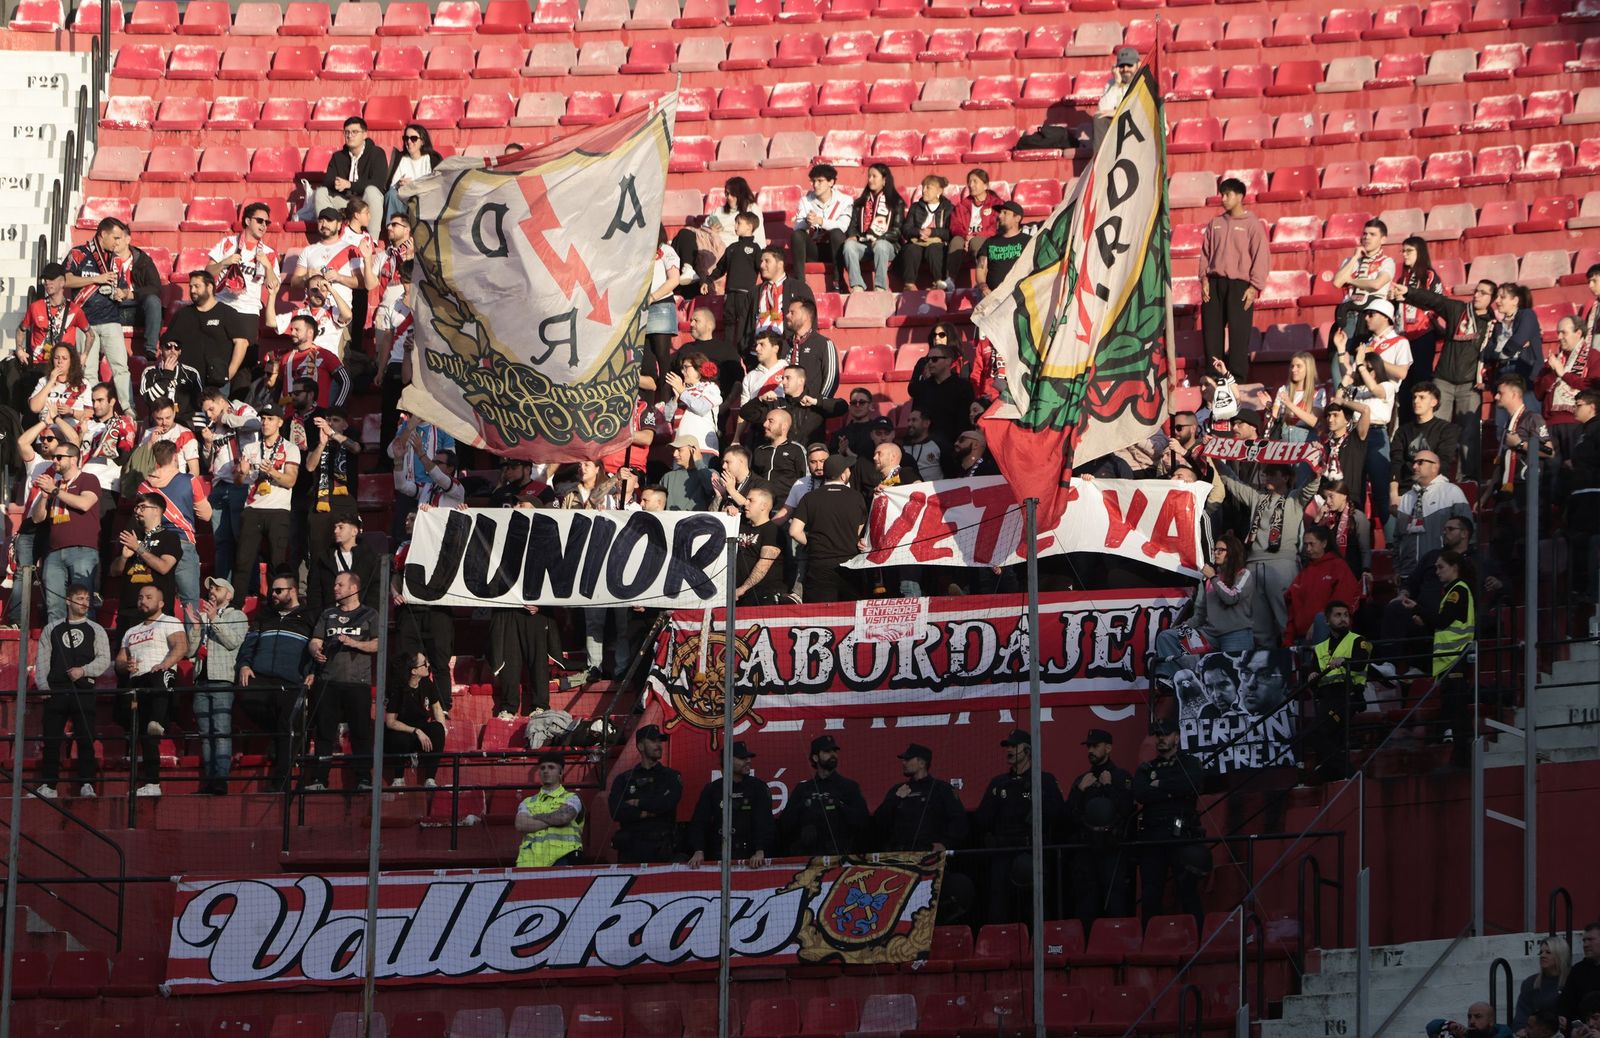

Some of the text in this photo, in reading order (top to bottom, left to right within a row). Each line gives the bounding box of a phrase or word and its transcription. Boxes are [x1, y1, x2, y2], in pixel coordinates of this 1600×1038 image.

[28, 76, 59, 88] F22
[1263, 441, 1304, 461] VETE
[1102, 488, 1198, 571] YA
[404, 510, 727, 601] JUNIOR
[866, 605, 918, 615] ENTRADAS
[865, 614, 917, 624] VISITANTES
[327, 627, 361, 636] DIGI
[178, 874, 810, 982] Vallekas
